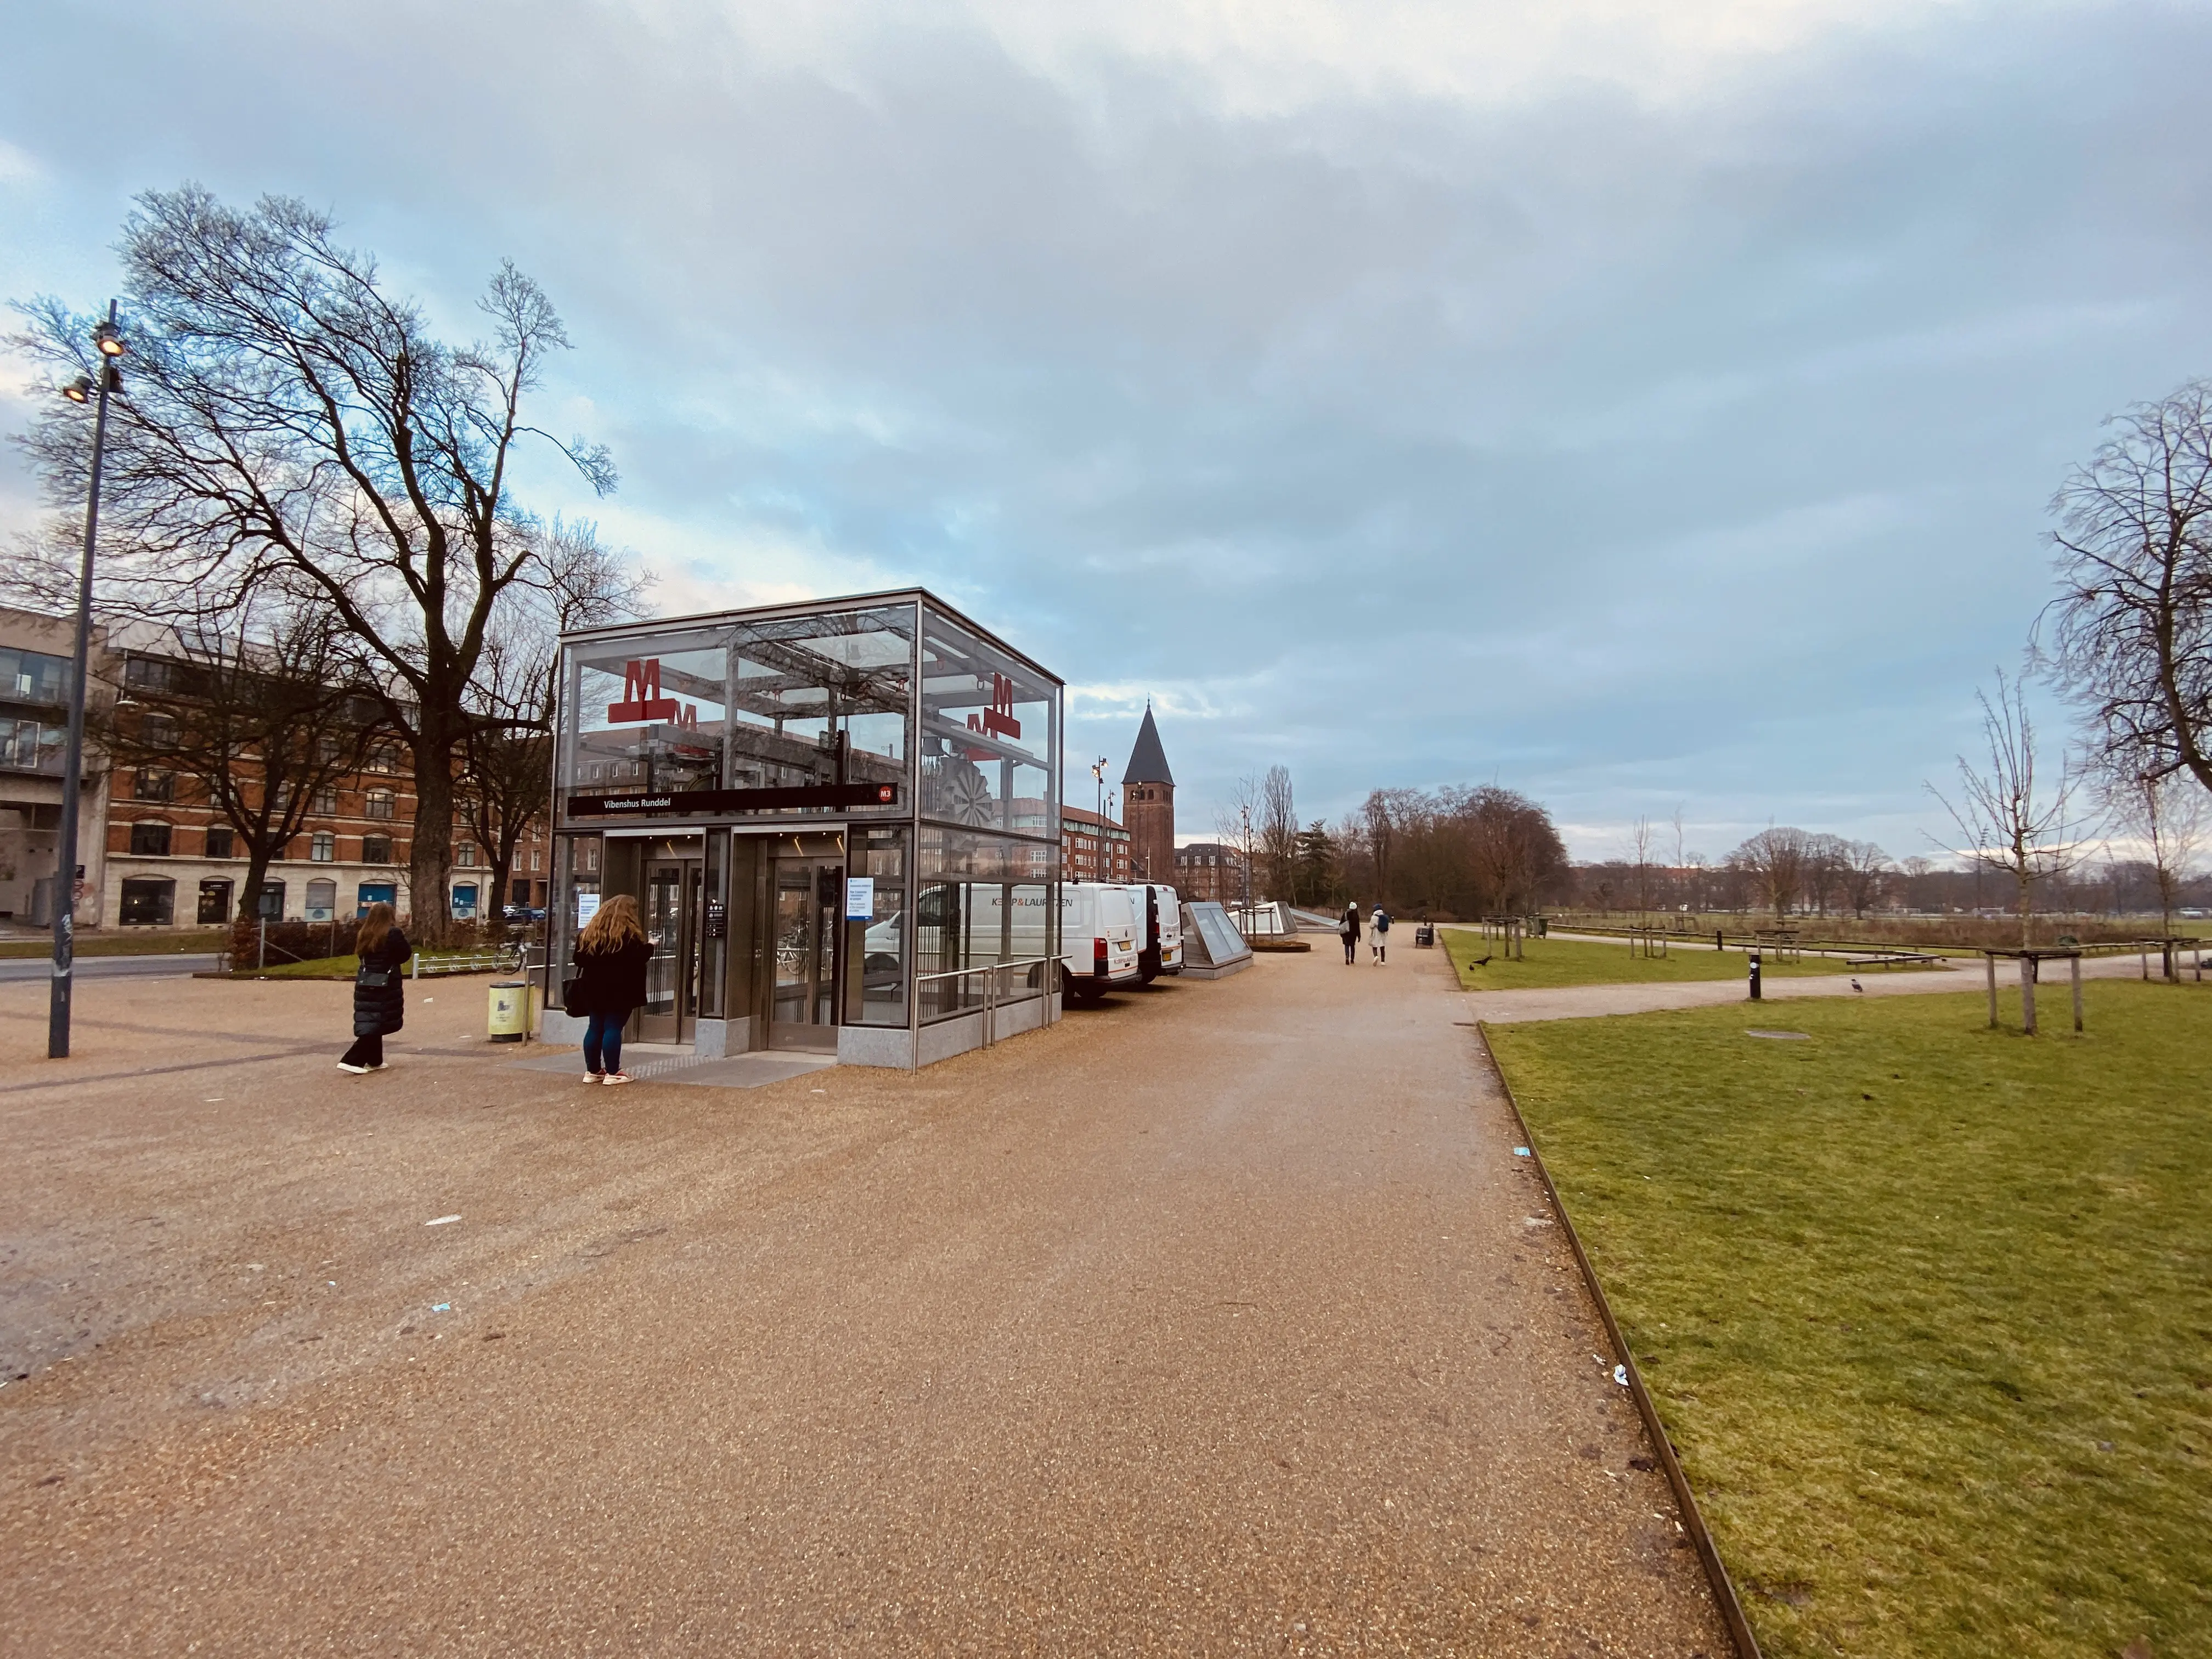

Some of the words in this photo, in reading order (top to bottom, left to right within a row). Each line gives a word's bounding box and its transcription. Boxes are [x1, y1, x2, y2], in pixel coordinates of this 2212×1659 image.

[604, 799, 639, 809] Vibenshus
[641, 797, 671, 807] Runddel
[992, 898, 1073, 907] KEP&LAUREN
